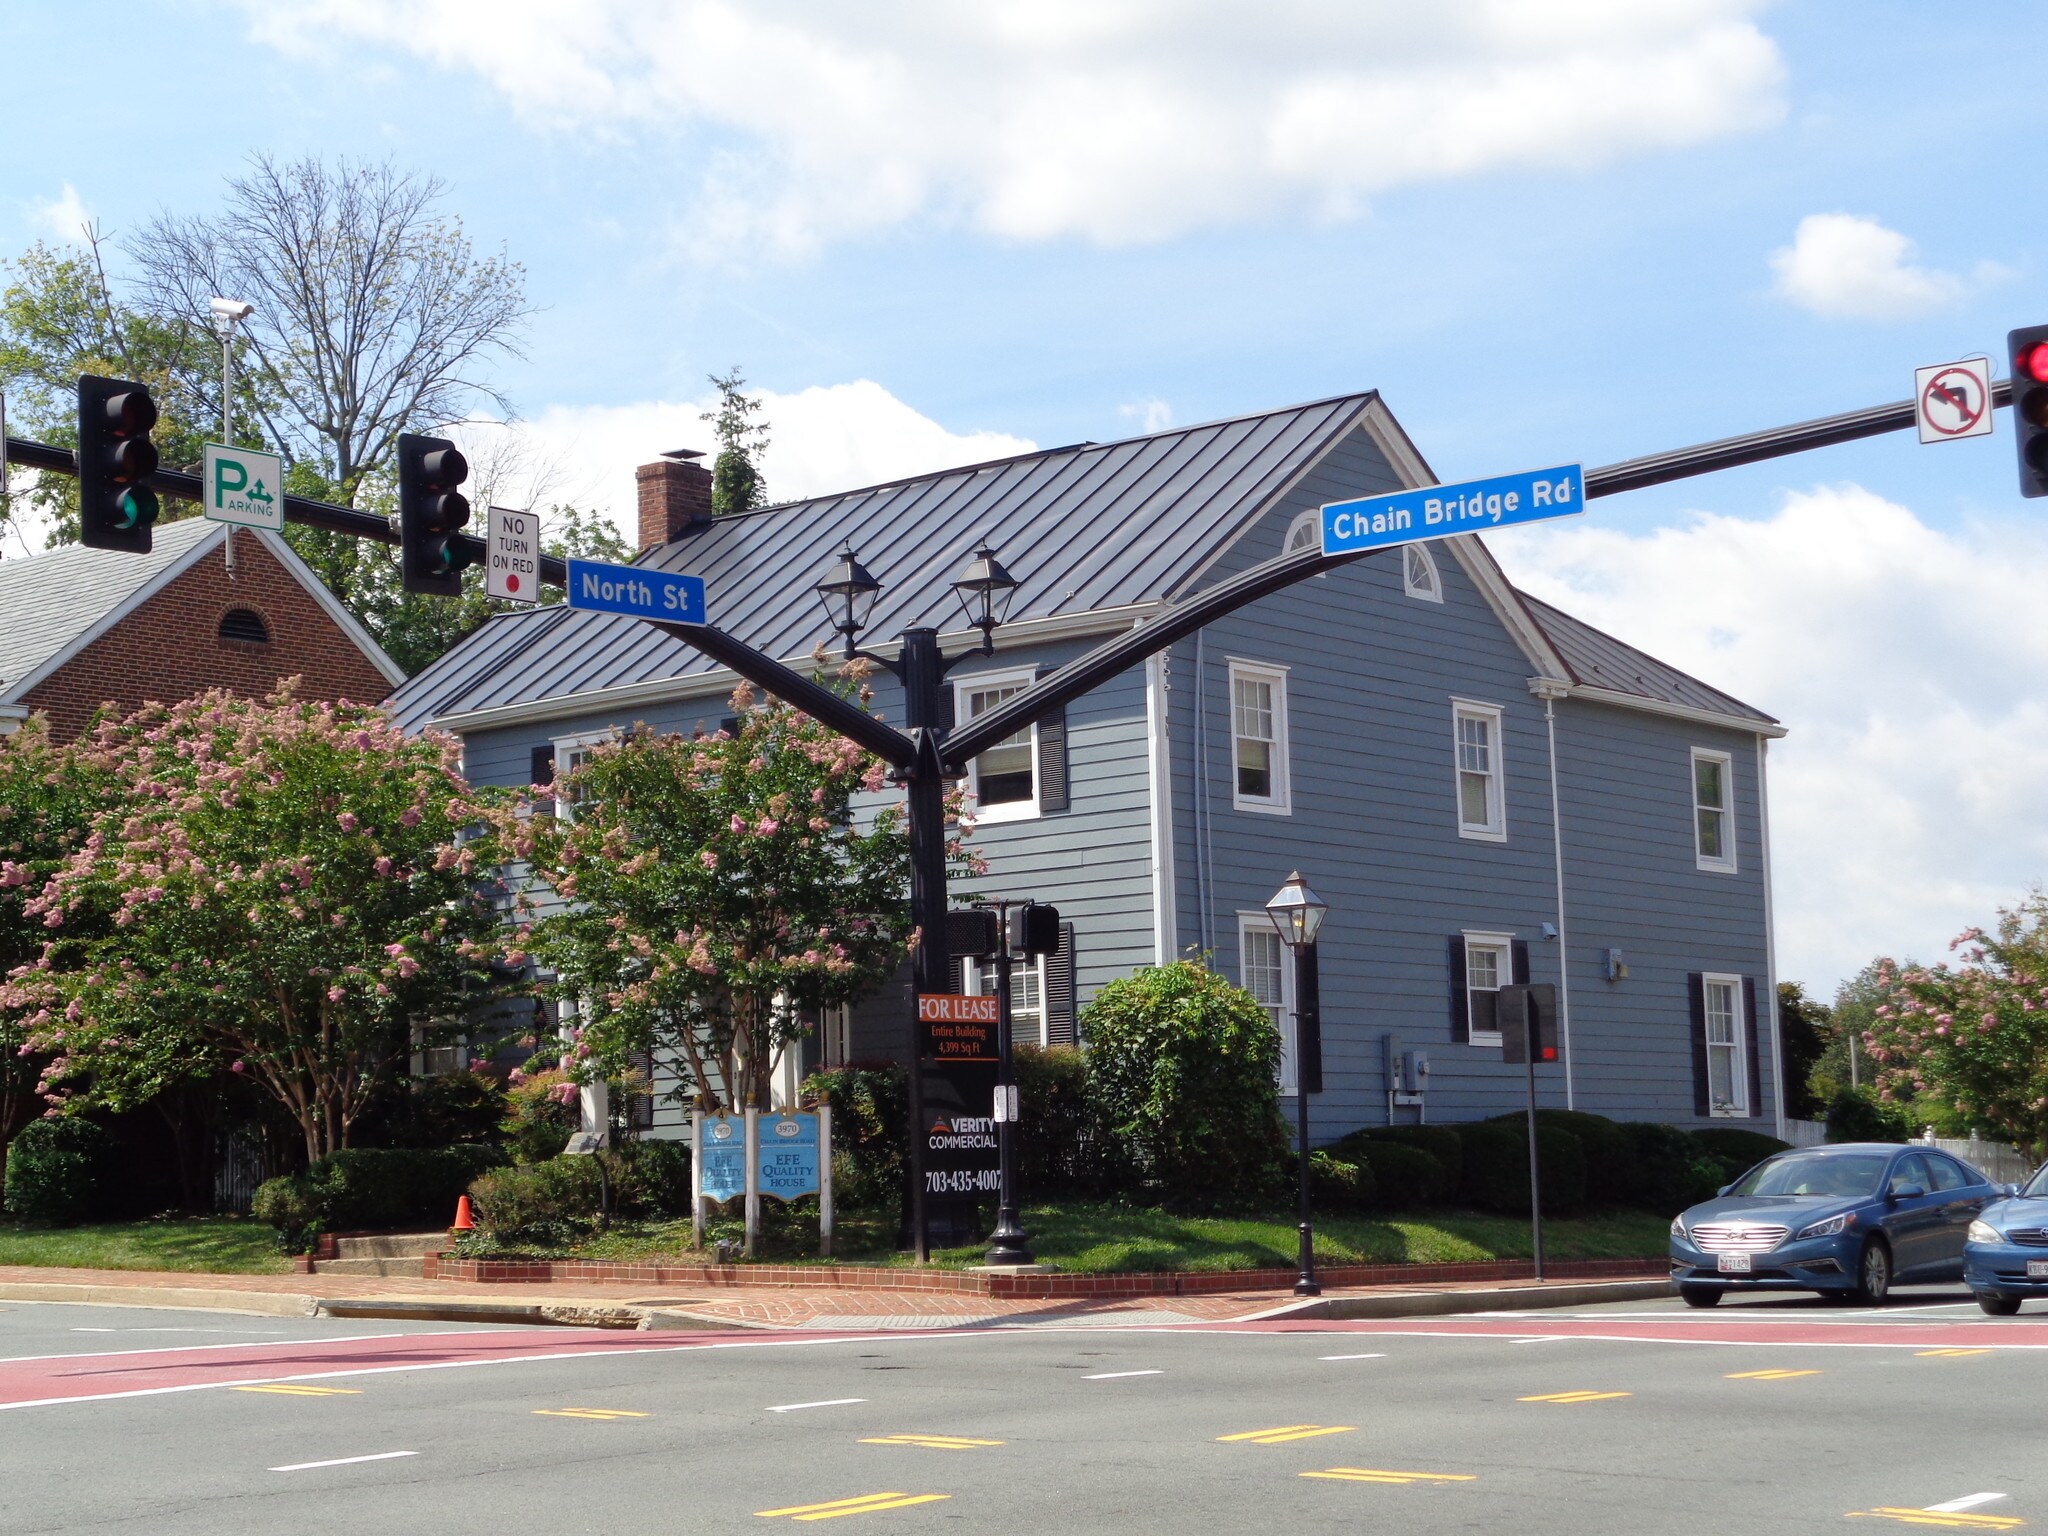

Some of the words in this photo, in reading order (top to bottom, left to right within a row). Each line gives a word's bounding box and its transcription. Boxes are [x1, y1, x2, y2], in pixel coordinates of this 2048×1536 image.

[1333, 506, 1411, 540] Chain
[1425, 491, 1518, 525] Bridge
[1532, 477, 1570, 507] Rd
[503, 516, 524, 535] NO
[499, 537, 528, 554] TURN
[493, 555, 508, 569] ON
[512, 558, 533, 573] RED
[582, 573, 651, 606] North
[663, 584, 688, 611] St
[918, 998, 951, 1019] FOR
[954, 999, 997, 1020] LEASE
[931, 1025, 954, 1037] Entire
[955, 1026, 986, 1041] Building
[938, 1042, 959, 1053] 4,399
[961, 1042, 971, 1056] Sq
[972, 1042, 980, 1053] Ft
[777, 1125, 797, 1133] 3970
[951, 1117, 995, 1133] VERITY
[928, 1135, 998, 1149] COMMERCIAL
[776, 1154, 800, 1165] EFE
[762, 1165, 813, 1178] QUALITY
[770, 1178, 805, 1187] HOUSE
[925, 1169, 1001, 1192] 703-435-4007
